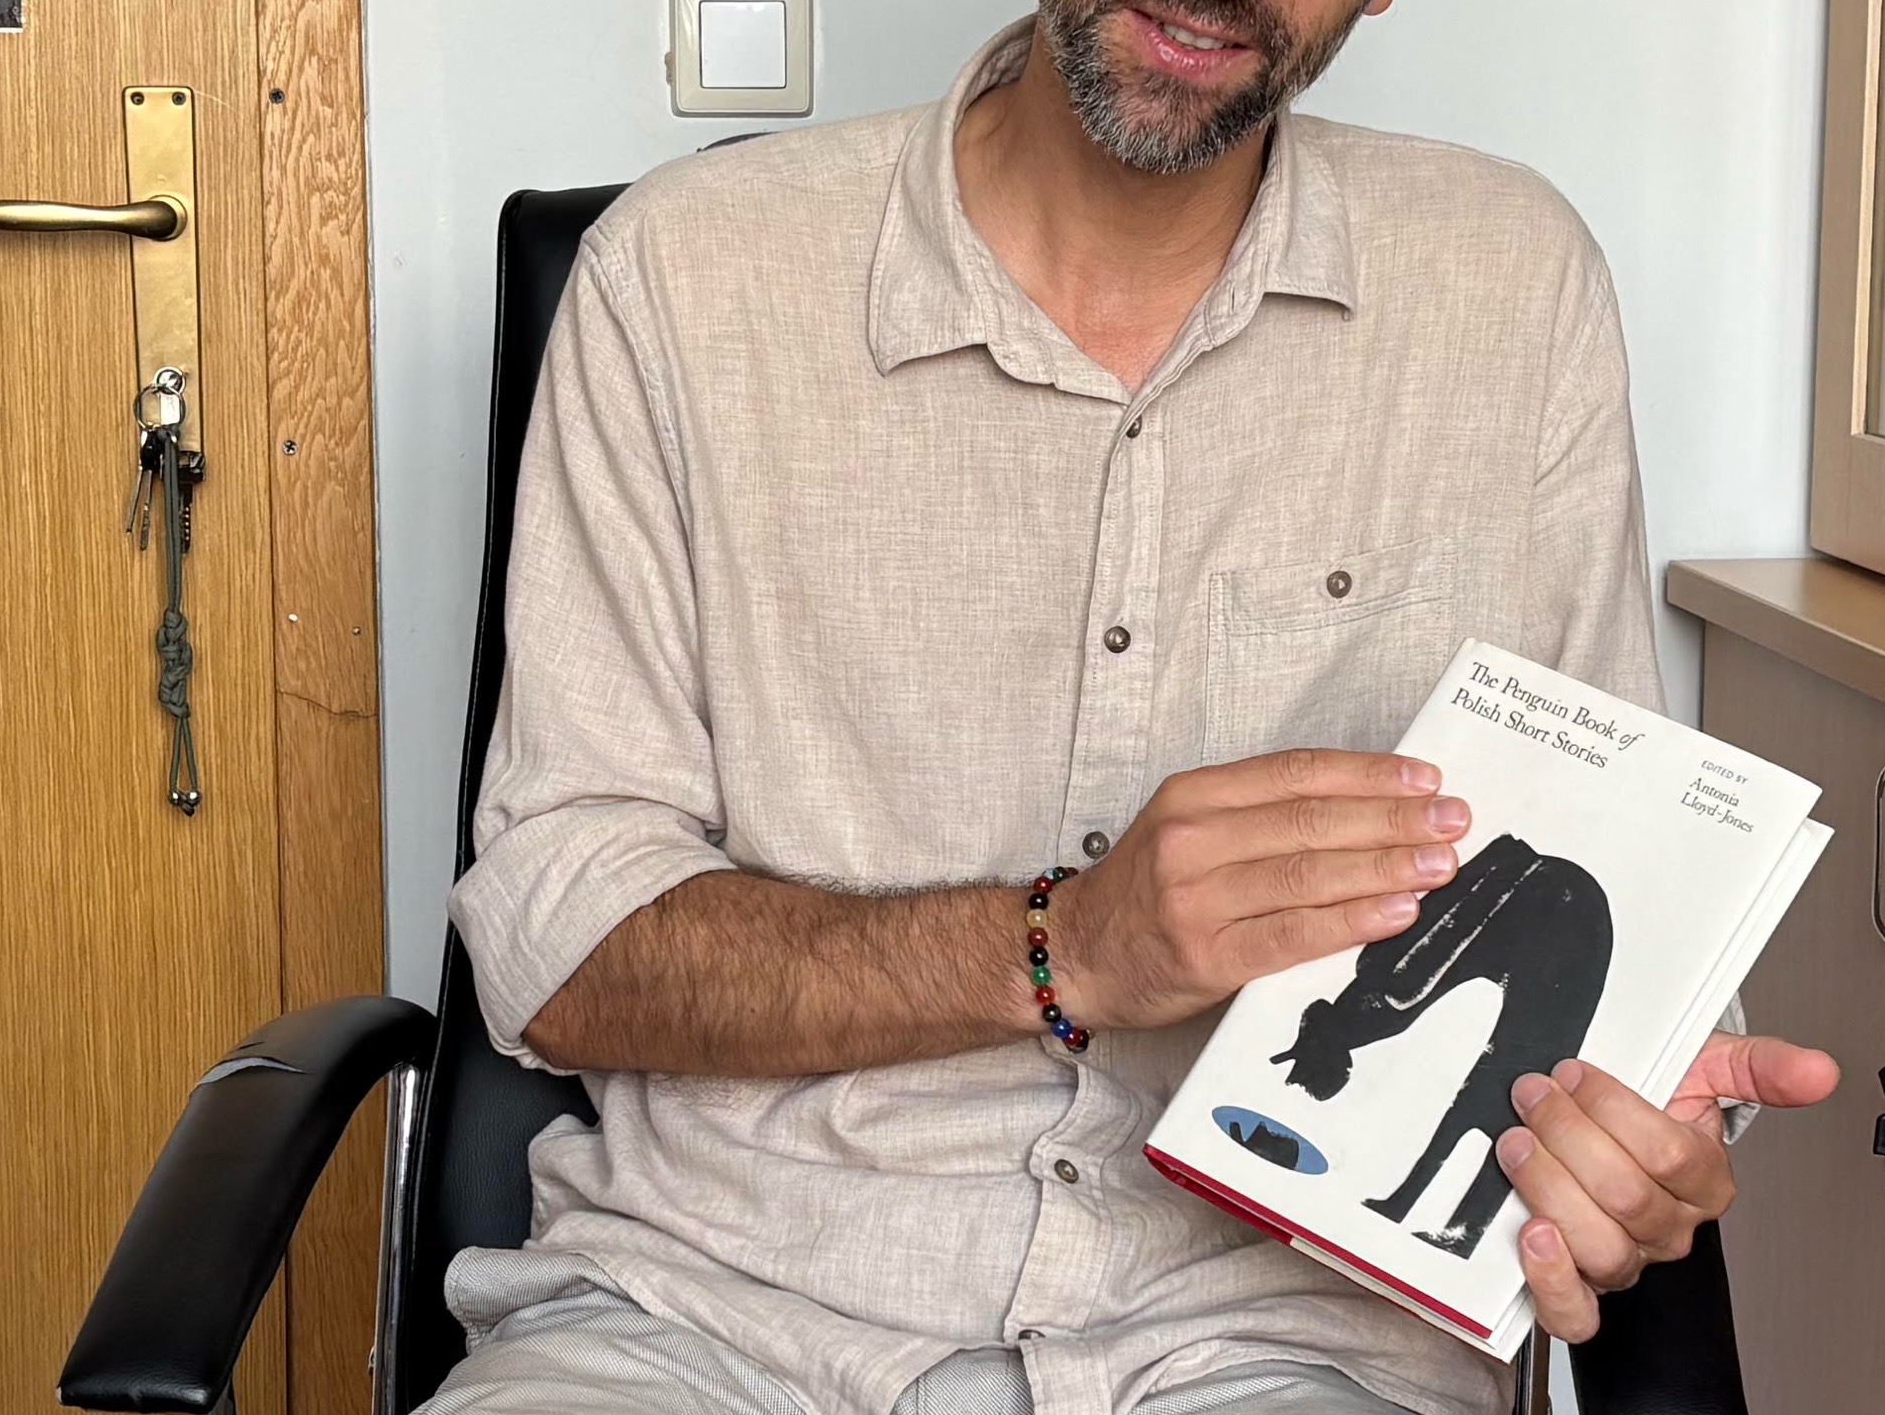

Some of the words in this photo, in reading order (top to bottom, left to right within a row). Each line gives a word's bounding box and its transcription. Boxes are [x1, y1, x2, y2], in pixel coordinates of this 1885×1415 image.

[1469, 661, 1499, 688] The
[1501, 677, 1569, 719] Penguin
[1572, 707, 1618, 739] Book
[1618, 732, 1645, 751] of
[1451, 688, 1501, 722] Polish
[1504, 711, 1550, 743] Short
[1551, 730, 1608, 769] Stories
[1689, 777, 1739, 807] Antonia
[1701, 760, 1734, 780] EDITED
[1736, 774, 1748, 785] BY
[1681, 793, 1754, 834] Lloyd-Jones
